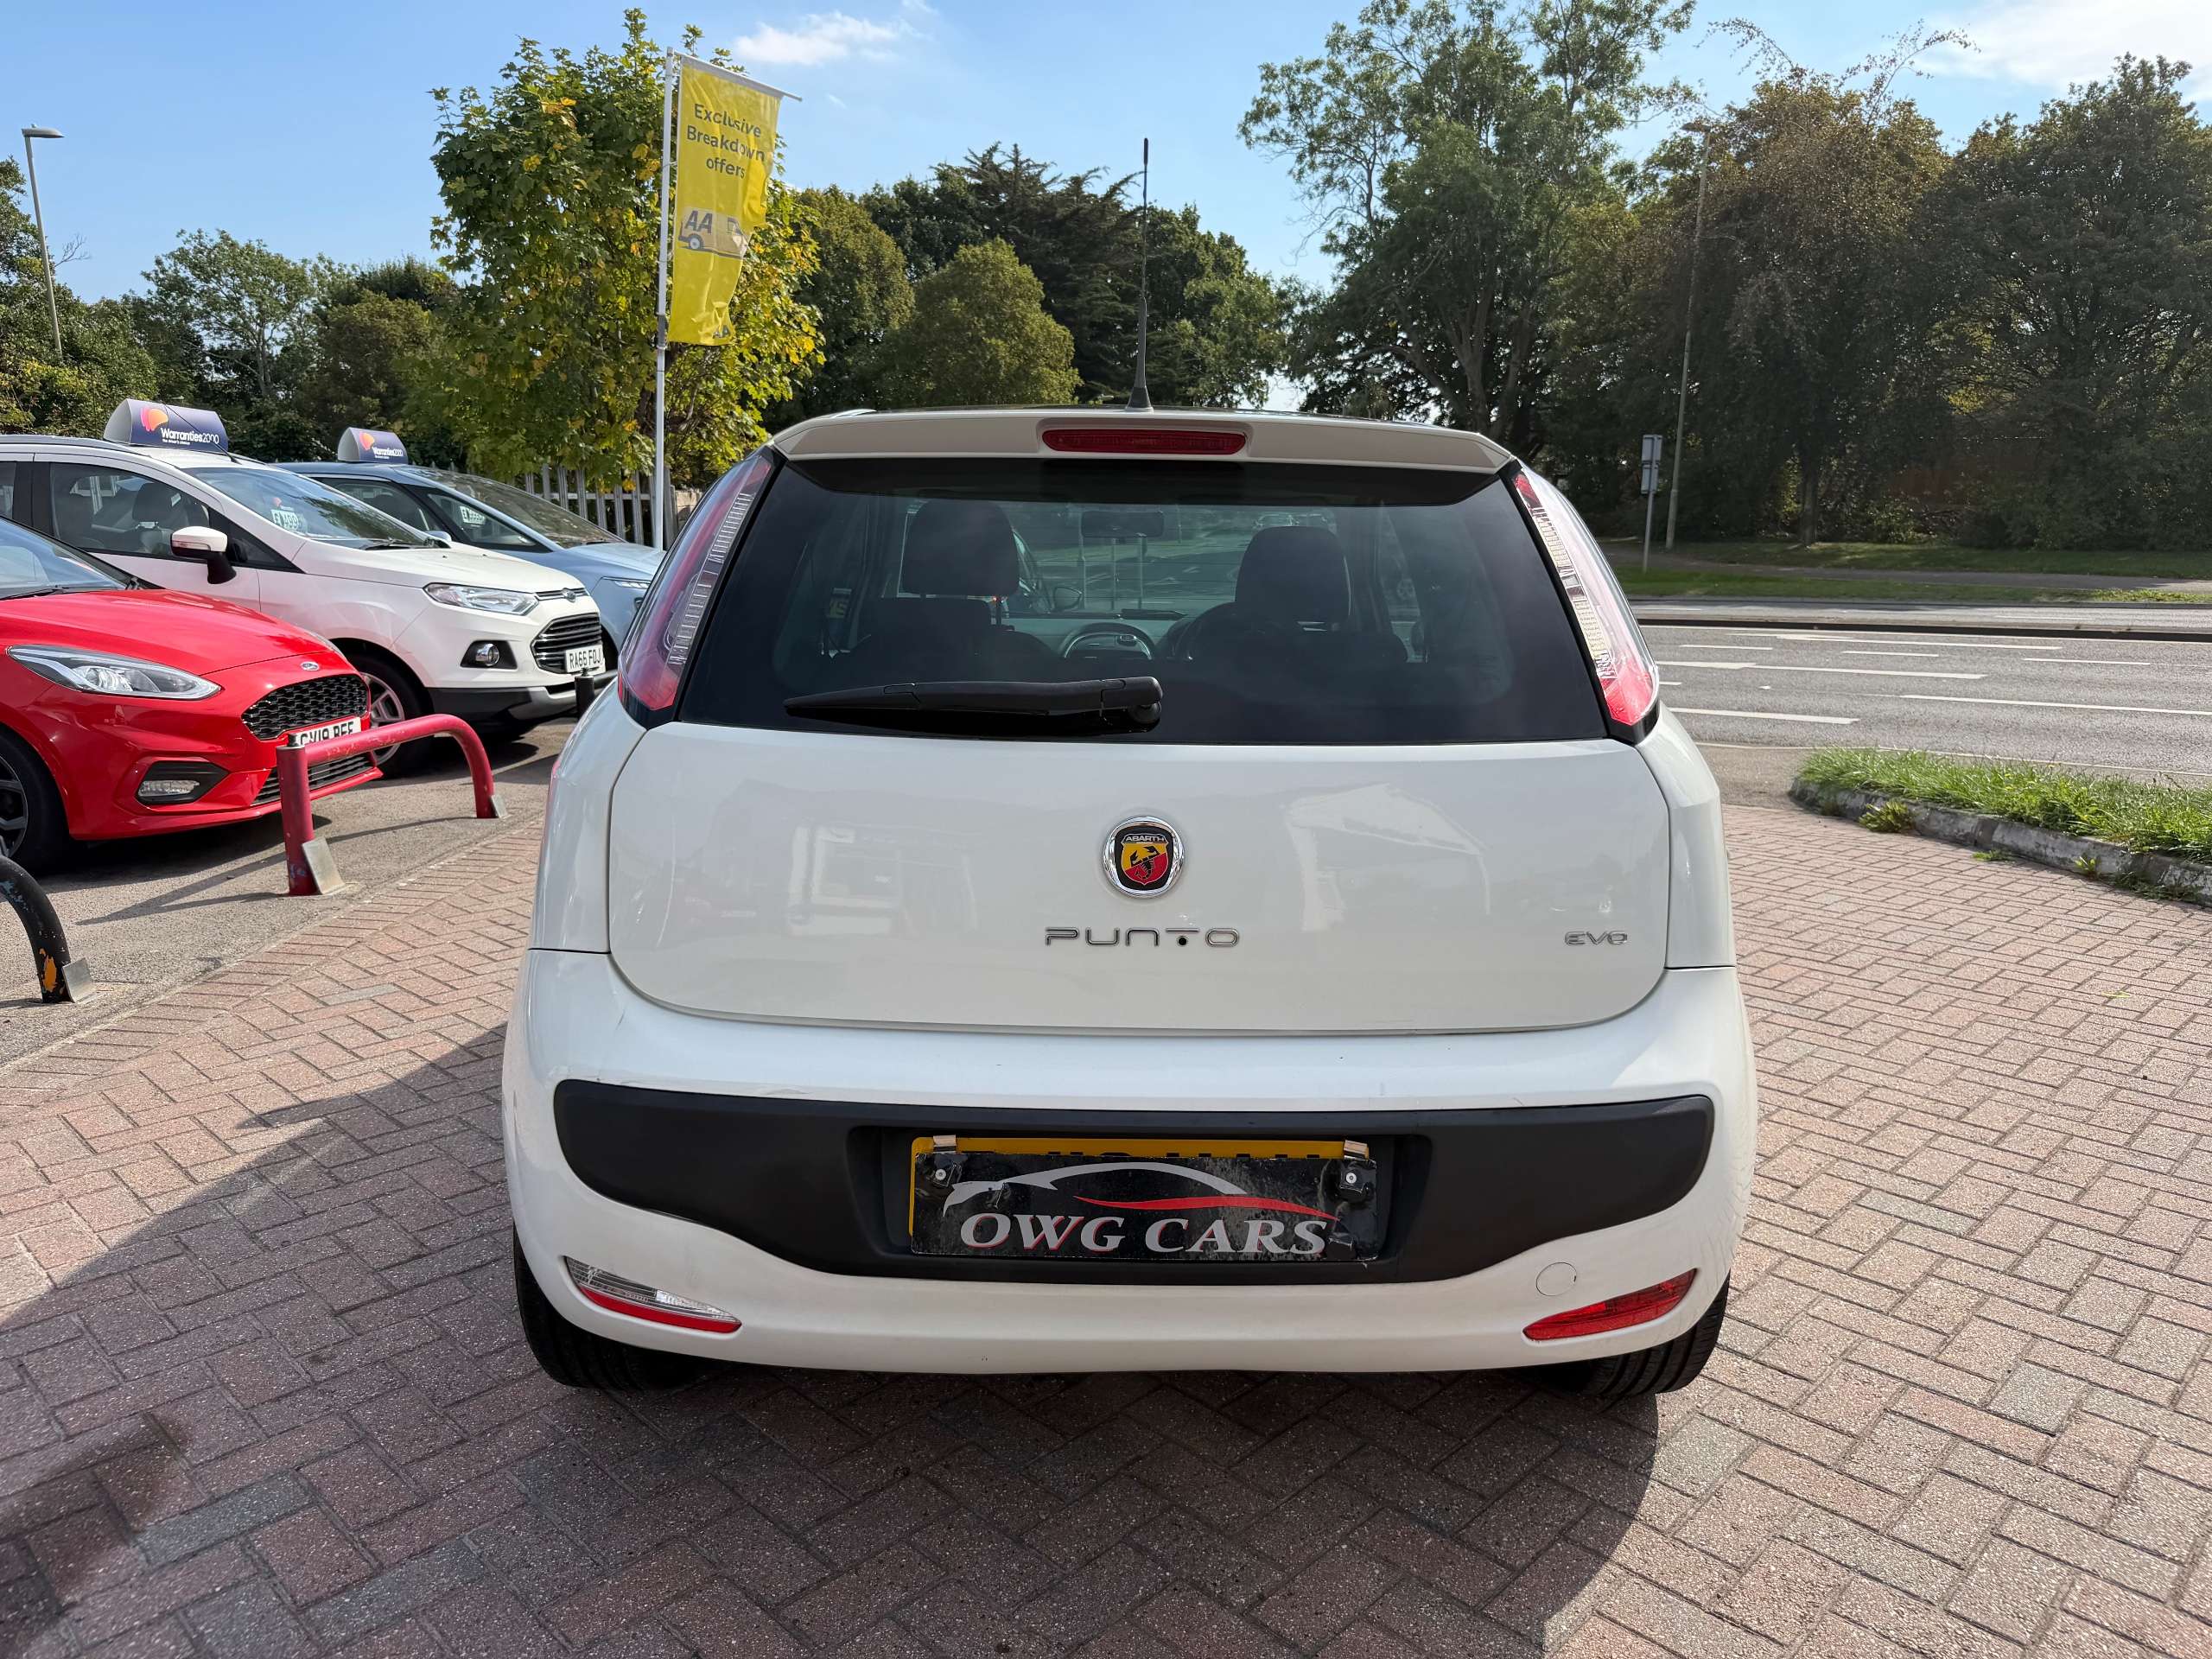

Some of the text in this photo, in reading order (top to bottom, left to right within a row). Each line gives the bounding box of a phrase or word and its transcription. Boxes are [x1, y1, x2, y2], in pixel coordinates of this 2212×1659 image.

[695, 104, 761, 138] Exclusive
[687, 125, 765, 162] Breakdown
[706, 157, 746, 180] offers
[683, 210, 713, 234] AA
[161, 428, 219, 444] Warranties2000
[1046, 927, 1240, 947] PUNTO
[1565, 931, 1628, 946] EVO
[960, 1212, 1329, 1255] OWG CARS
